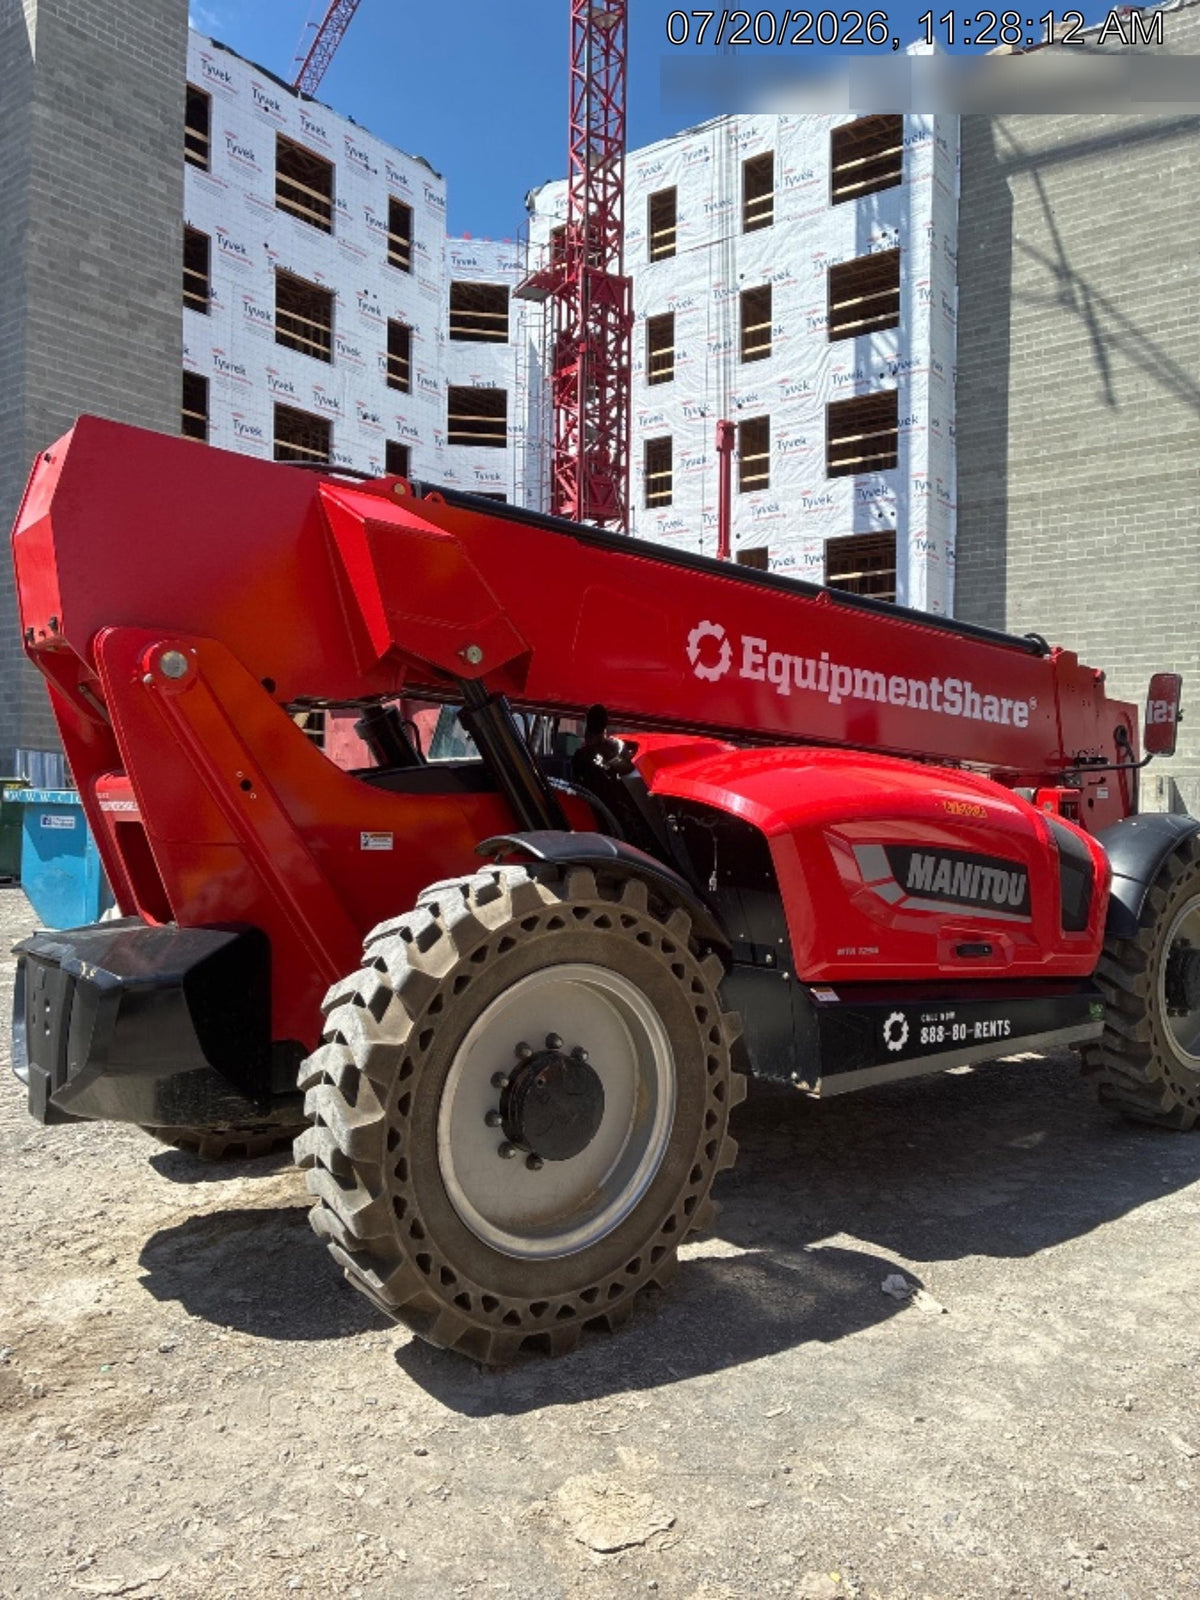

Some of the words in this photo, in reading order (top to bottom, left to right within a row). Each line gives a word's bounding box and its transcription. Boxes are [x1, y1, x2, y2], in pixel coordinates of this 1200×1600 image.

[201, 58, 232, 82] Tyvek
[252, 87, 280, 111] Tyvek
[225, 136, 255, 161] Tyvek
[785, 170, 813, 186] Tyvek
[216, 232, 247, 254] Tyvek
[243, 302, 272, 320] Tyvek
[267, 375, 294, 392] Tyvek
[313, 391, 339, 409] Tyvek
[776, 437, 806, 452] Tyvek
[801, 494, 832, 508] Tyvek
[855, 485, 888, 500] Tyvek
[750, 503, 779, 518] Tyvek
[739, 635, 1030, 728] EquipmentShare
[906, 852, 1027, 906] MANITOU
[920, 1020, 1011, 1044] 888-80-RENTS
